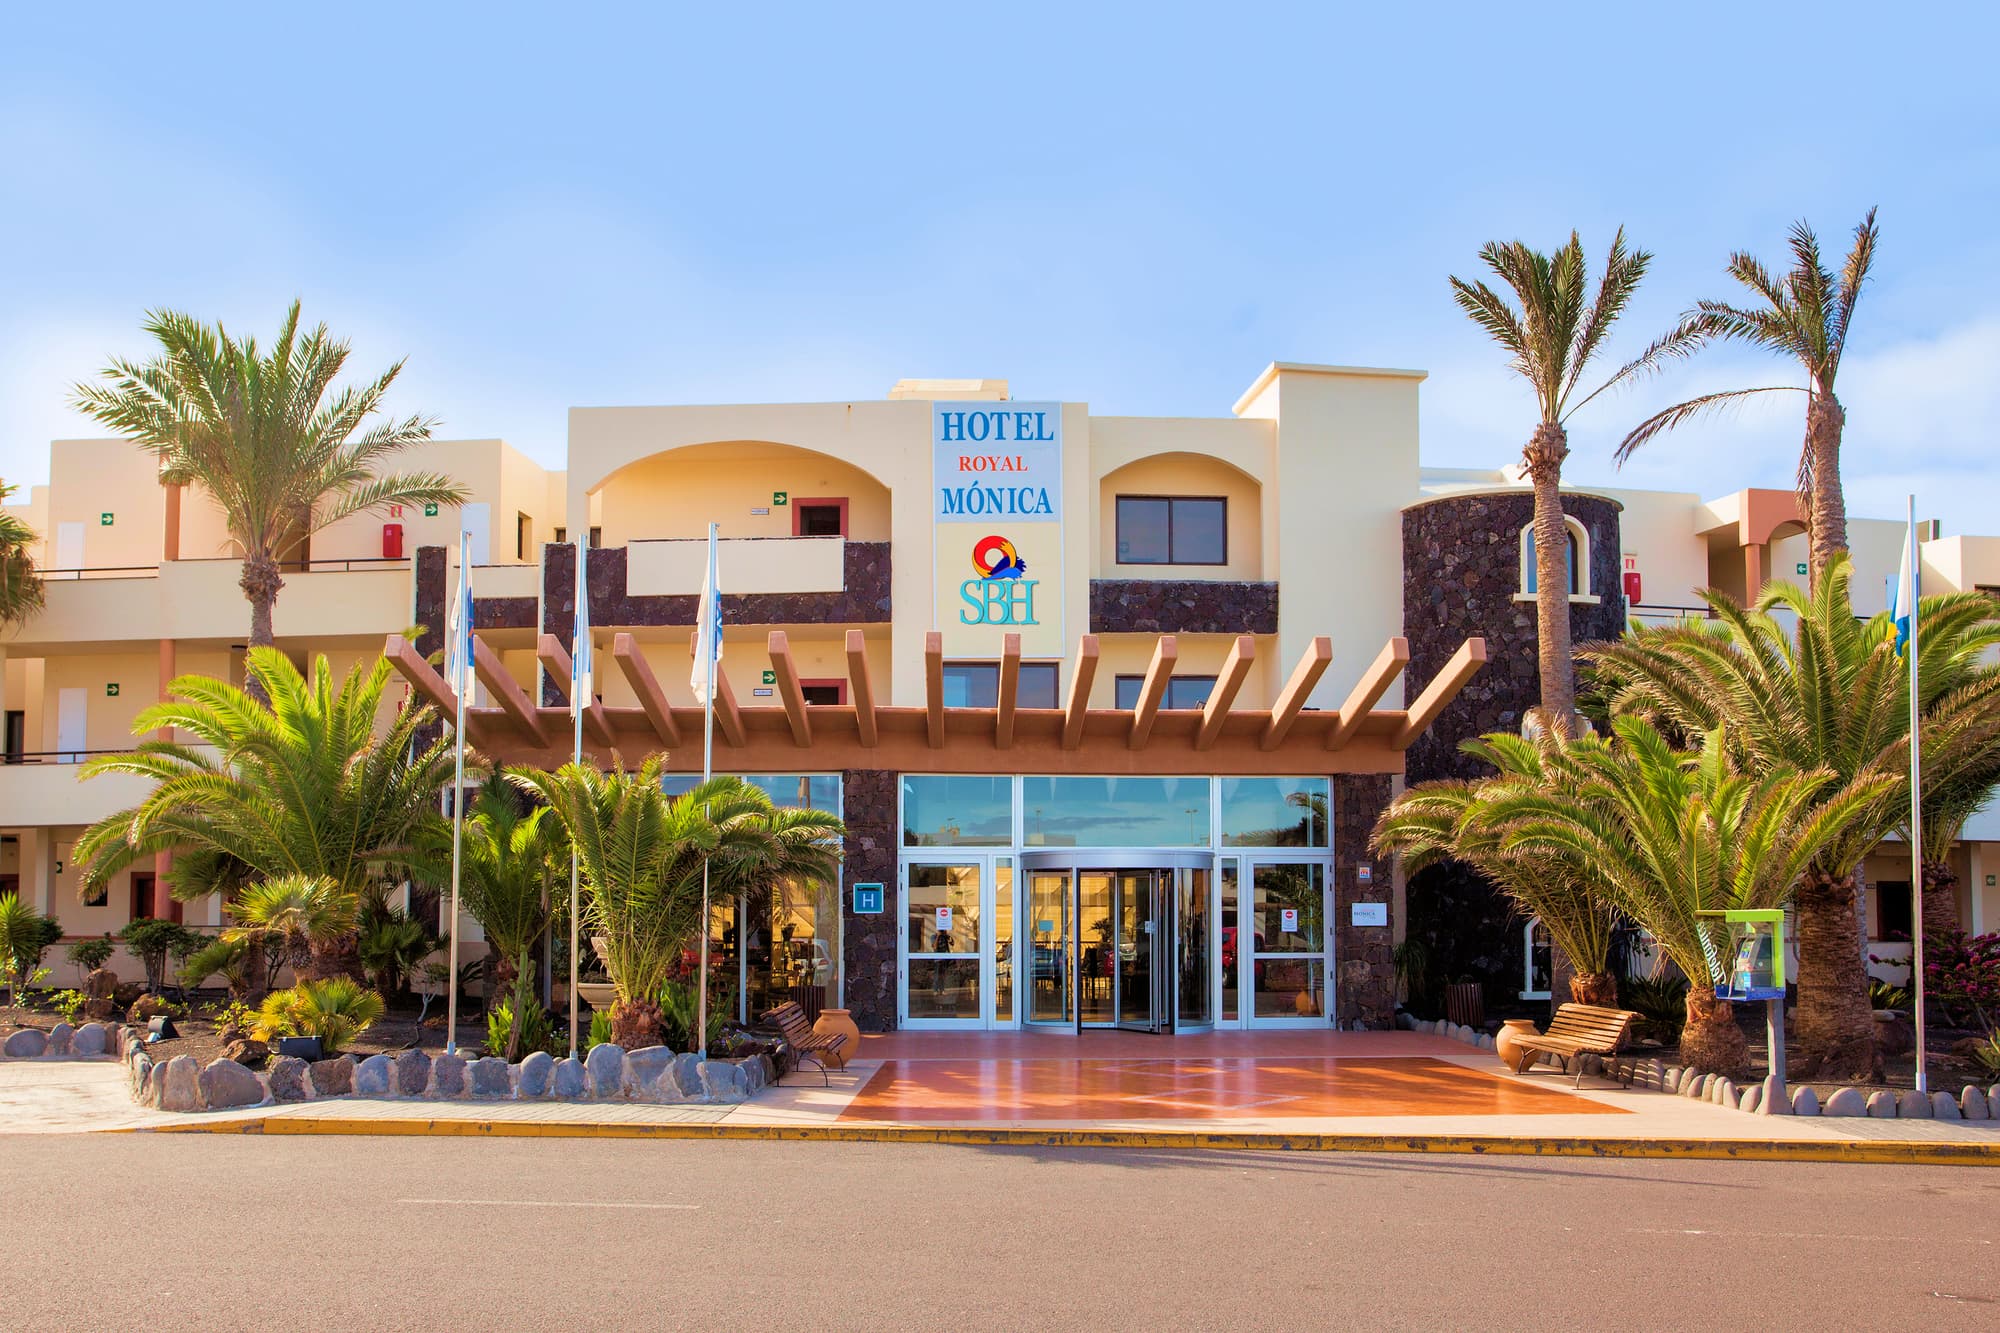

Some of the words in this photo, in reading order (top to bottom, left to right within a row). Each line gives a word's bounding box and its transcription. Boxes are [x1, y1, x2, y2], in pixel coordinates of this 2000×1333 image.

[941, 411, 1055, 442] HOTEL
[958, 455, 1029, 473] ROYAL
[941, 480, 1054, 514] MÓNICA
[959, 579, 1040, 625] SBH
[862, 893, 874, 908] H
